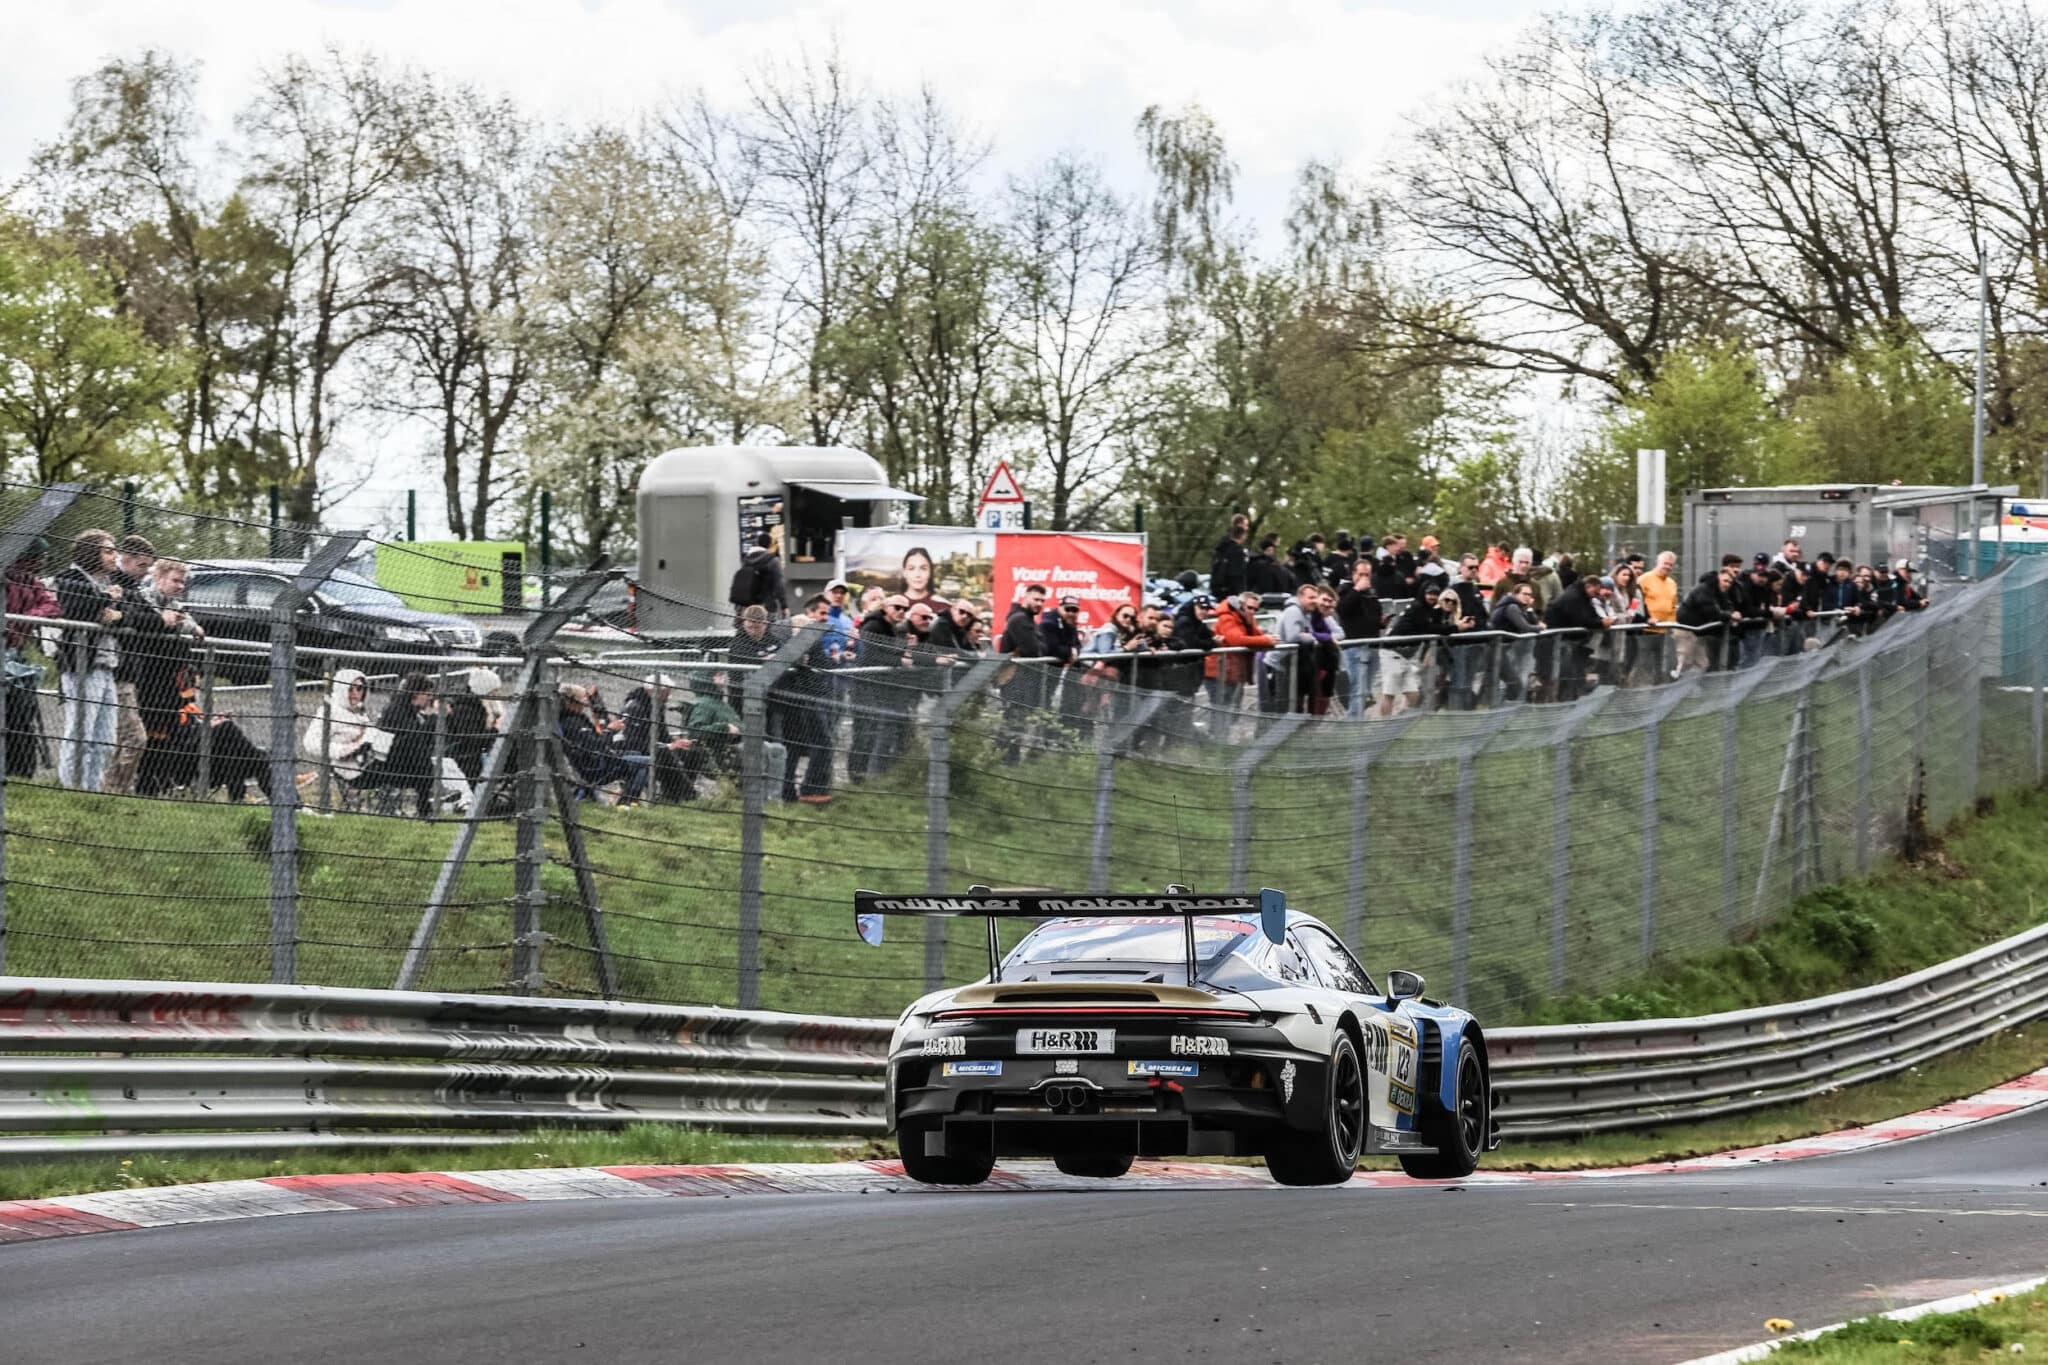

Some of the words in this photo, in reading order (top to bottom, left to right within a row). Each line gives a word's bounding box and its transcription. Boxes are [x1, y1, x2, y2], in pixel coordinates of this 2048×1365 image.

[1006, 511, 1024, 527] 98
[1012, 567, 1050, 581] Your
[1052, 565, 1098, 583] home
[874, 898, 1021, 911] mühlner
[1038, 897, 1254, 912] motorsport
[920, 1036, 949, 1056] H&R
[1032, 1031, 1073, 1049] H&R
[1171, 1035, 1208, 1055] H&R
[958, 1064, 997, 1072] MICHELIN
[1147, 1064, 1192, 1072] MICHELIN
[1396, 1045, 1411, 1082] 123
[1397, 1089, 1413, 1109] DEKRA
